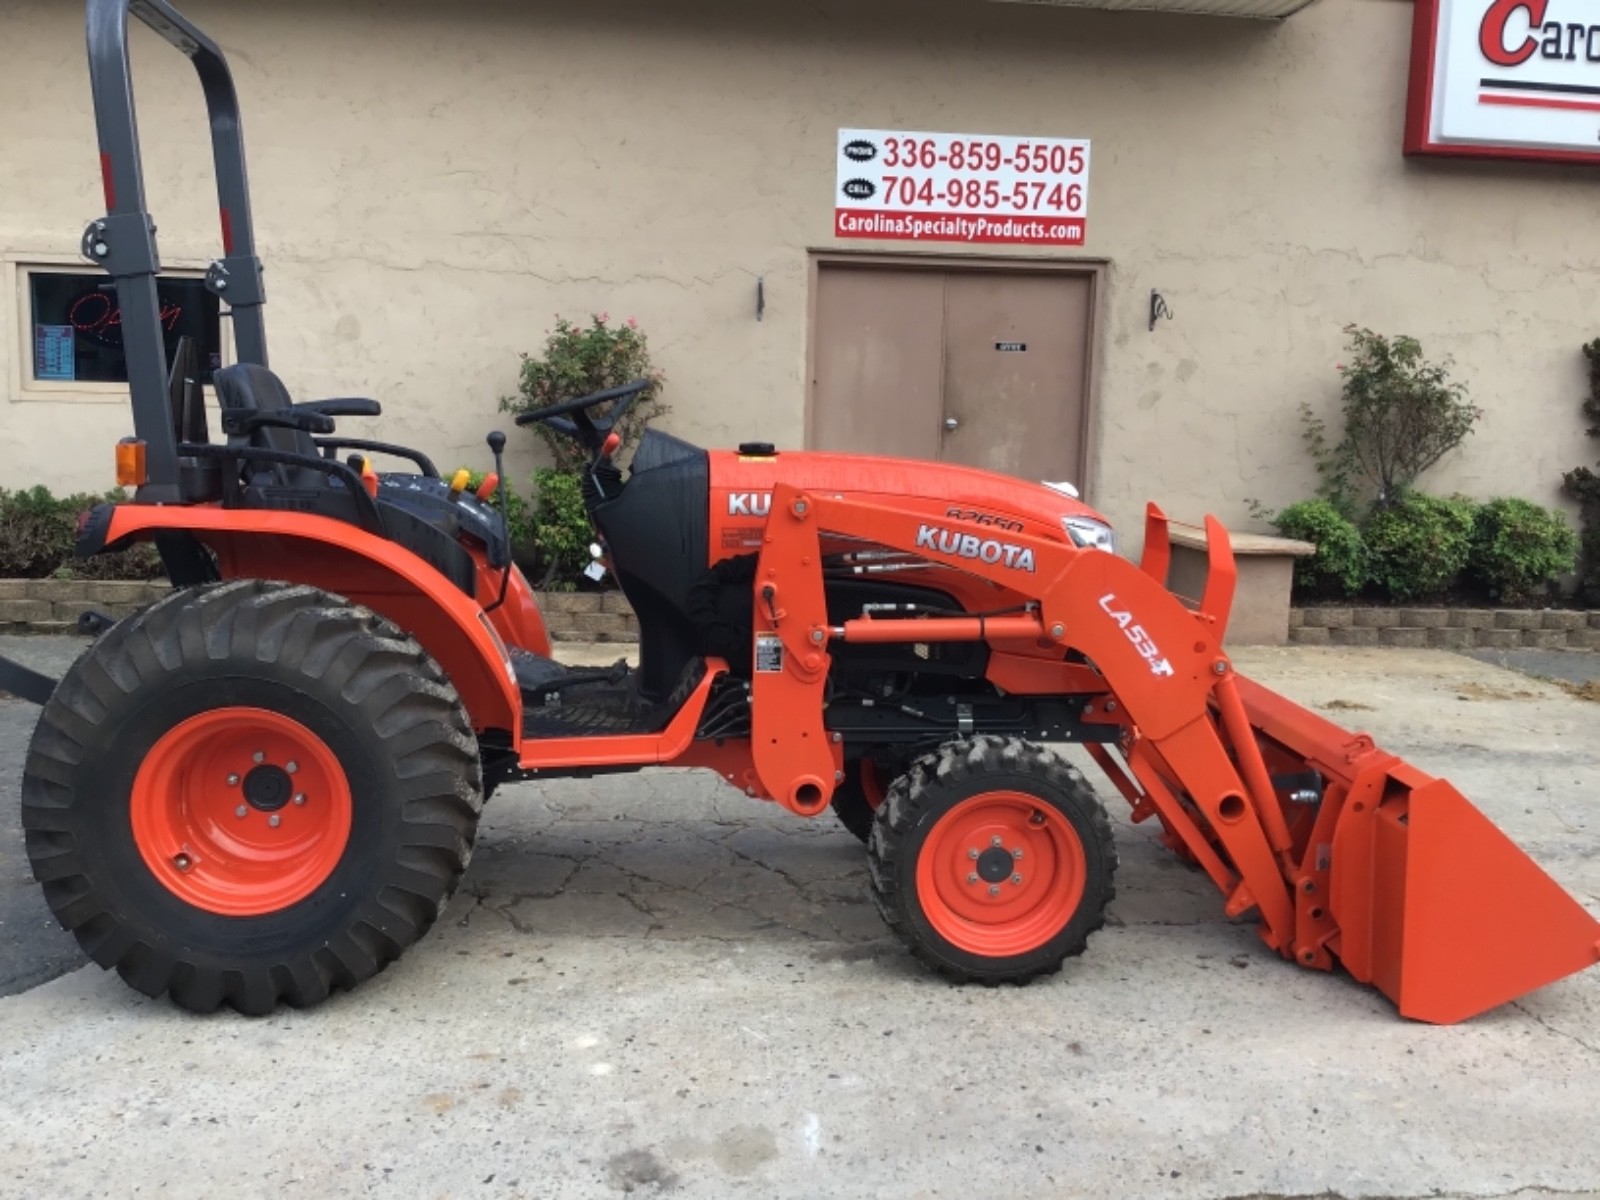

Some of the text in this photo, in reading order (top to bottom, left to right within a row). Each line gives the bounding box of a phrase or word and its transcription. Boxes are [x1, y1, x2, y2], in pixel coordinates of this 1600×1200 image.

[883, 137, 1085, 175] 336-859-5505
[881, 176, 1082, 212] 704-985-5746
[838, 212, 1082, 240] CarolinaSpecialtyProducts.com
[915, 525, 1036, 573] KUBOTA
